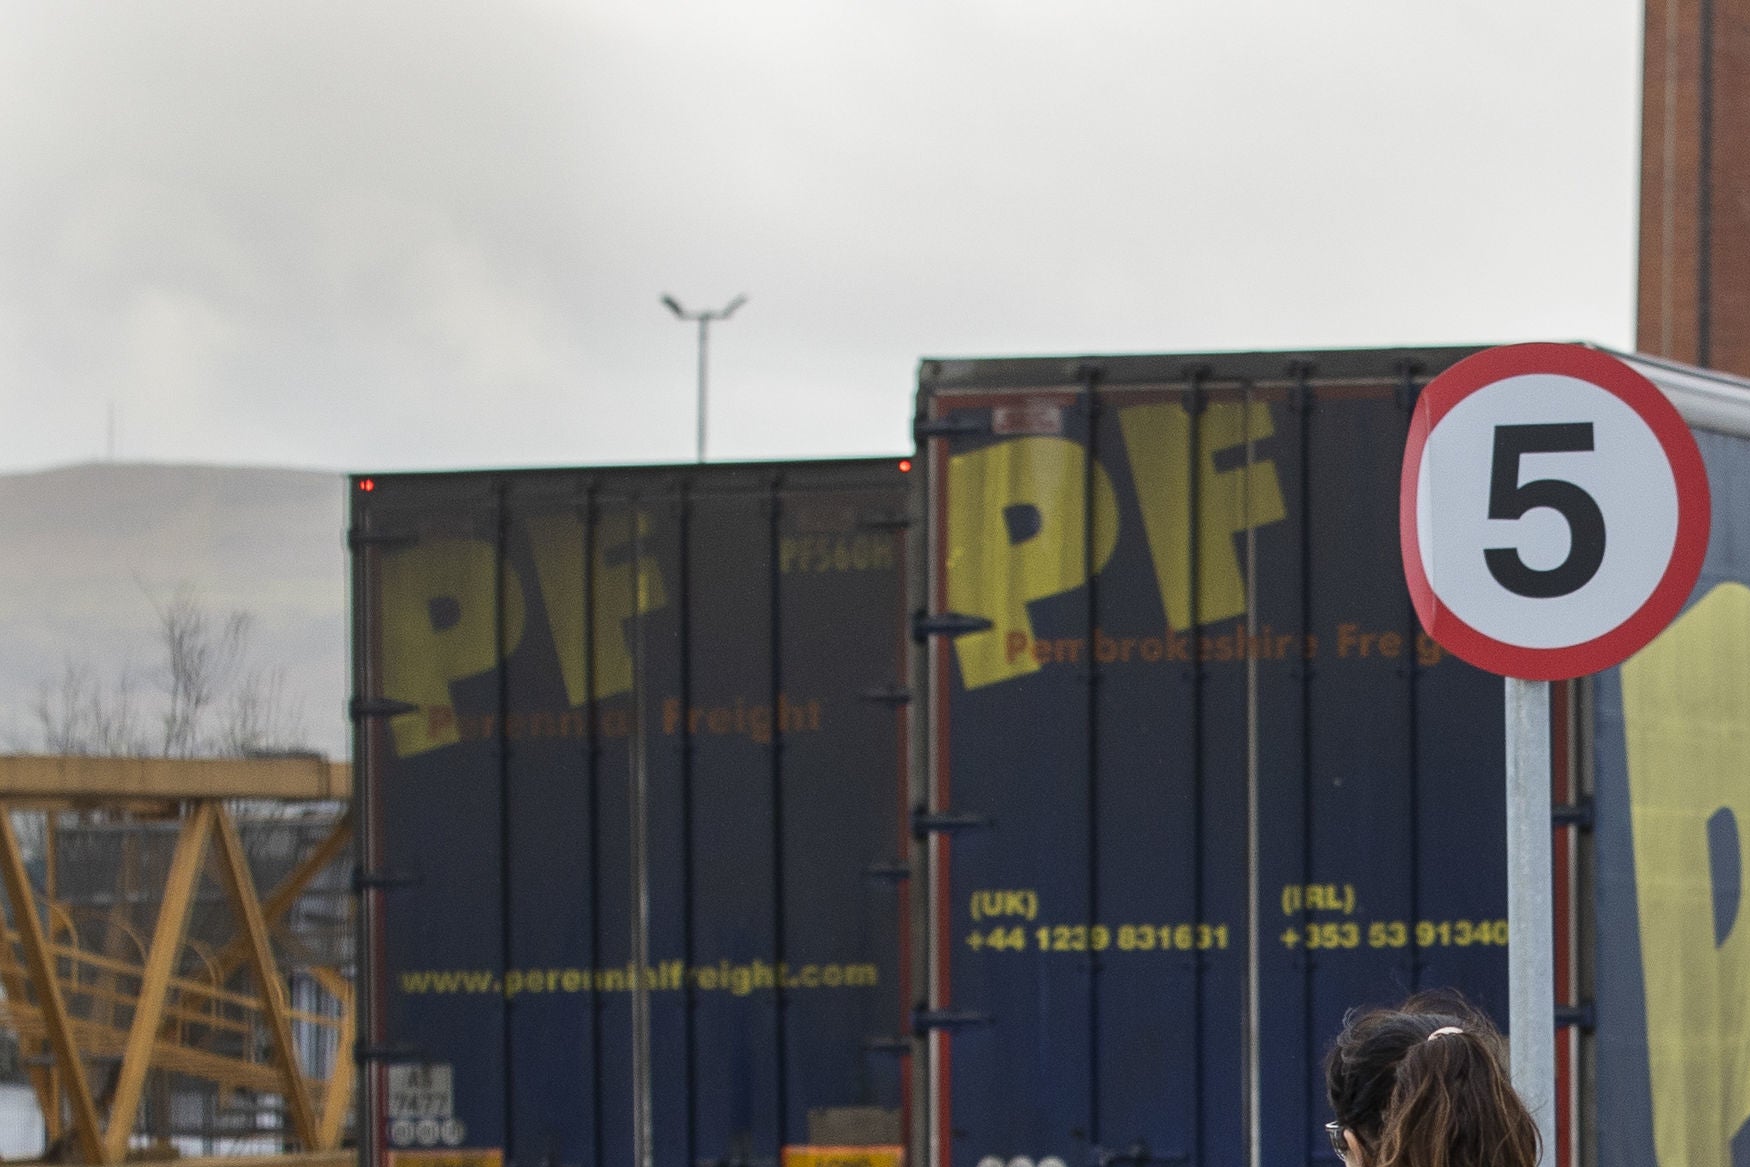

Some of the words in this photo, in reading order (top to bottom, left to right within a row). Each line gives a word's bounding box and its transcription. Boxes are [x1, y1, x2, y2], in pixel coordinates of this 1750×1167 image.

[1483, 421, 1606, 599] 5
[946, 400, 1287, 691] PF
[379, 511, 667, 759] PF
[970, 889, 1039, 920] (UK)
[1281, 884, 1357, 916] (IRL)
[966, 926, 1025, 951] +44
[1280, 922, 1360, 949] +353
[1368, 920, 1408, 948] 53
